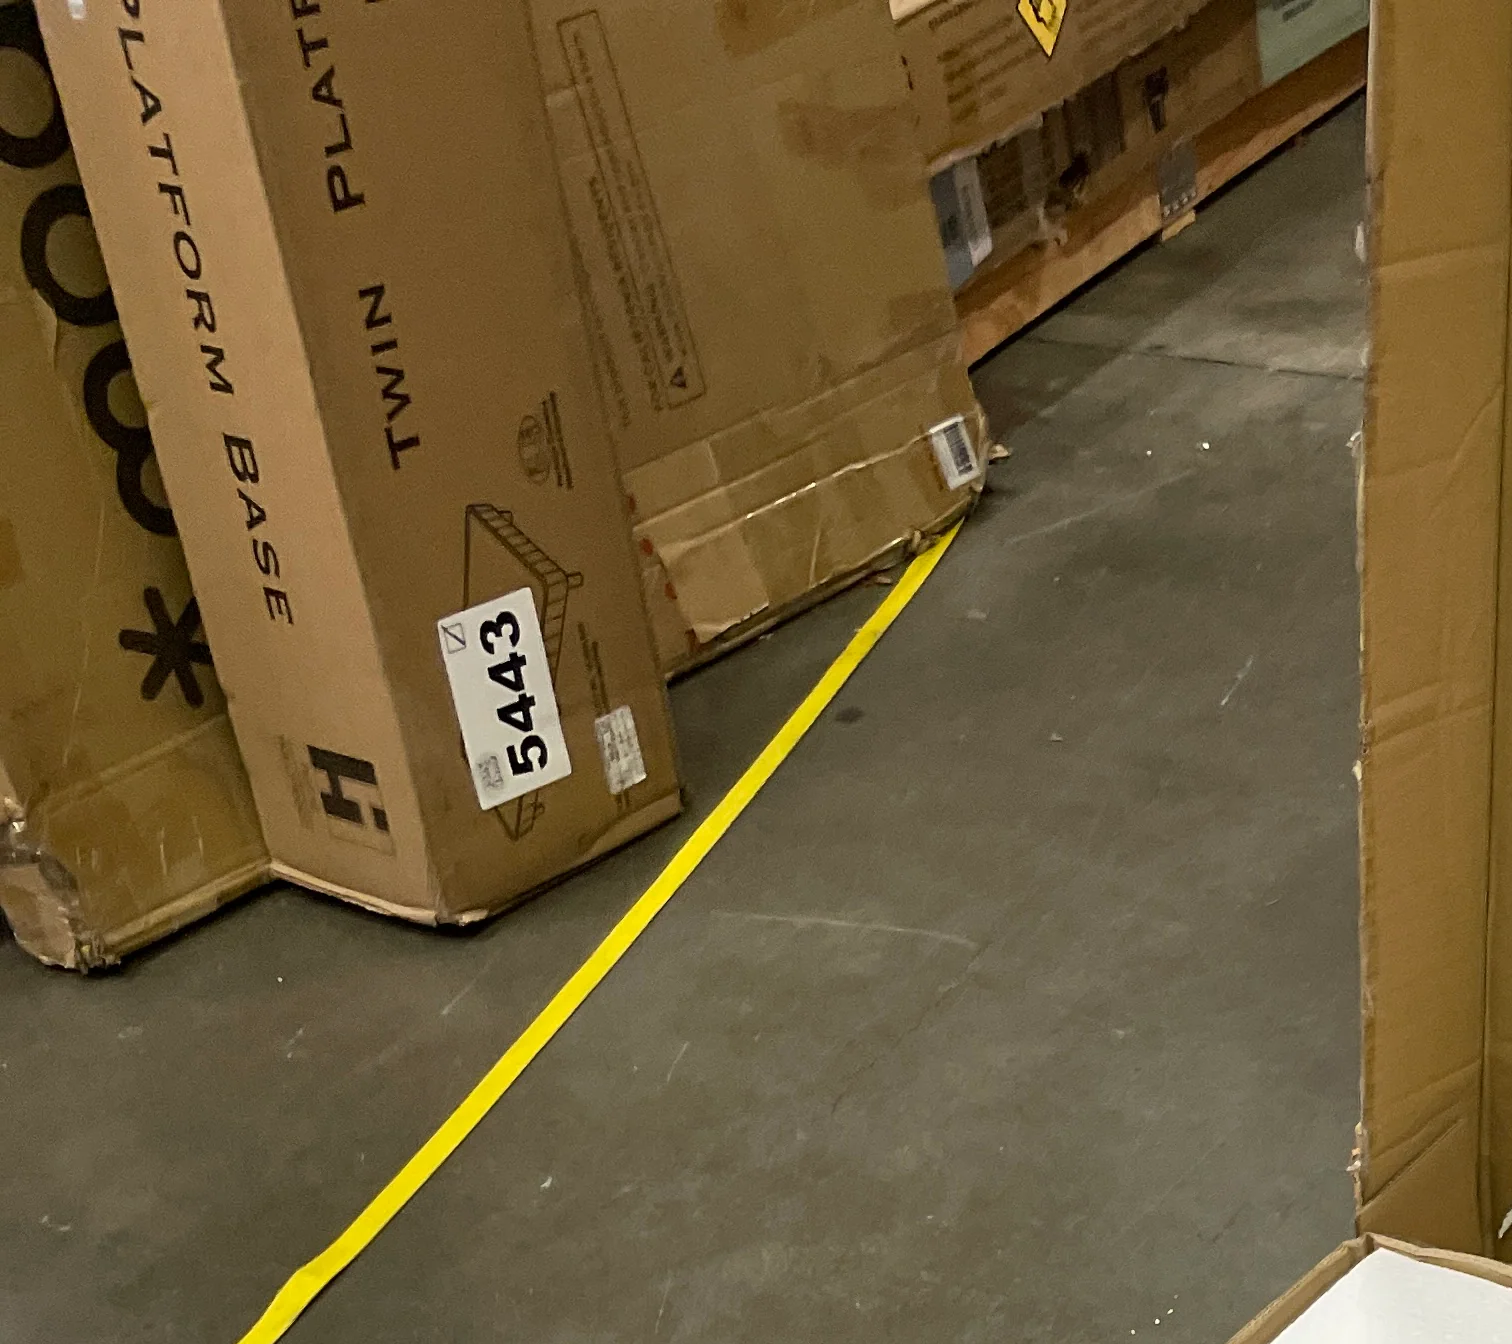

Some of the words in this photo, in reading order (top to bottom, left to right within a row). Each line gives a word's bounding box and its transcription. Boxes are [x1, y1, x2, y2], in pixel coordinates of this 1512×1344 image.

[358, 283, 422, 470] TWIN
[223, 430, 294, 627] BASE
[479, 610, 549, 777] 5443
